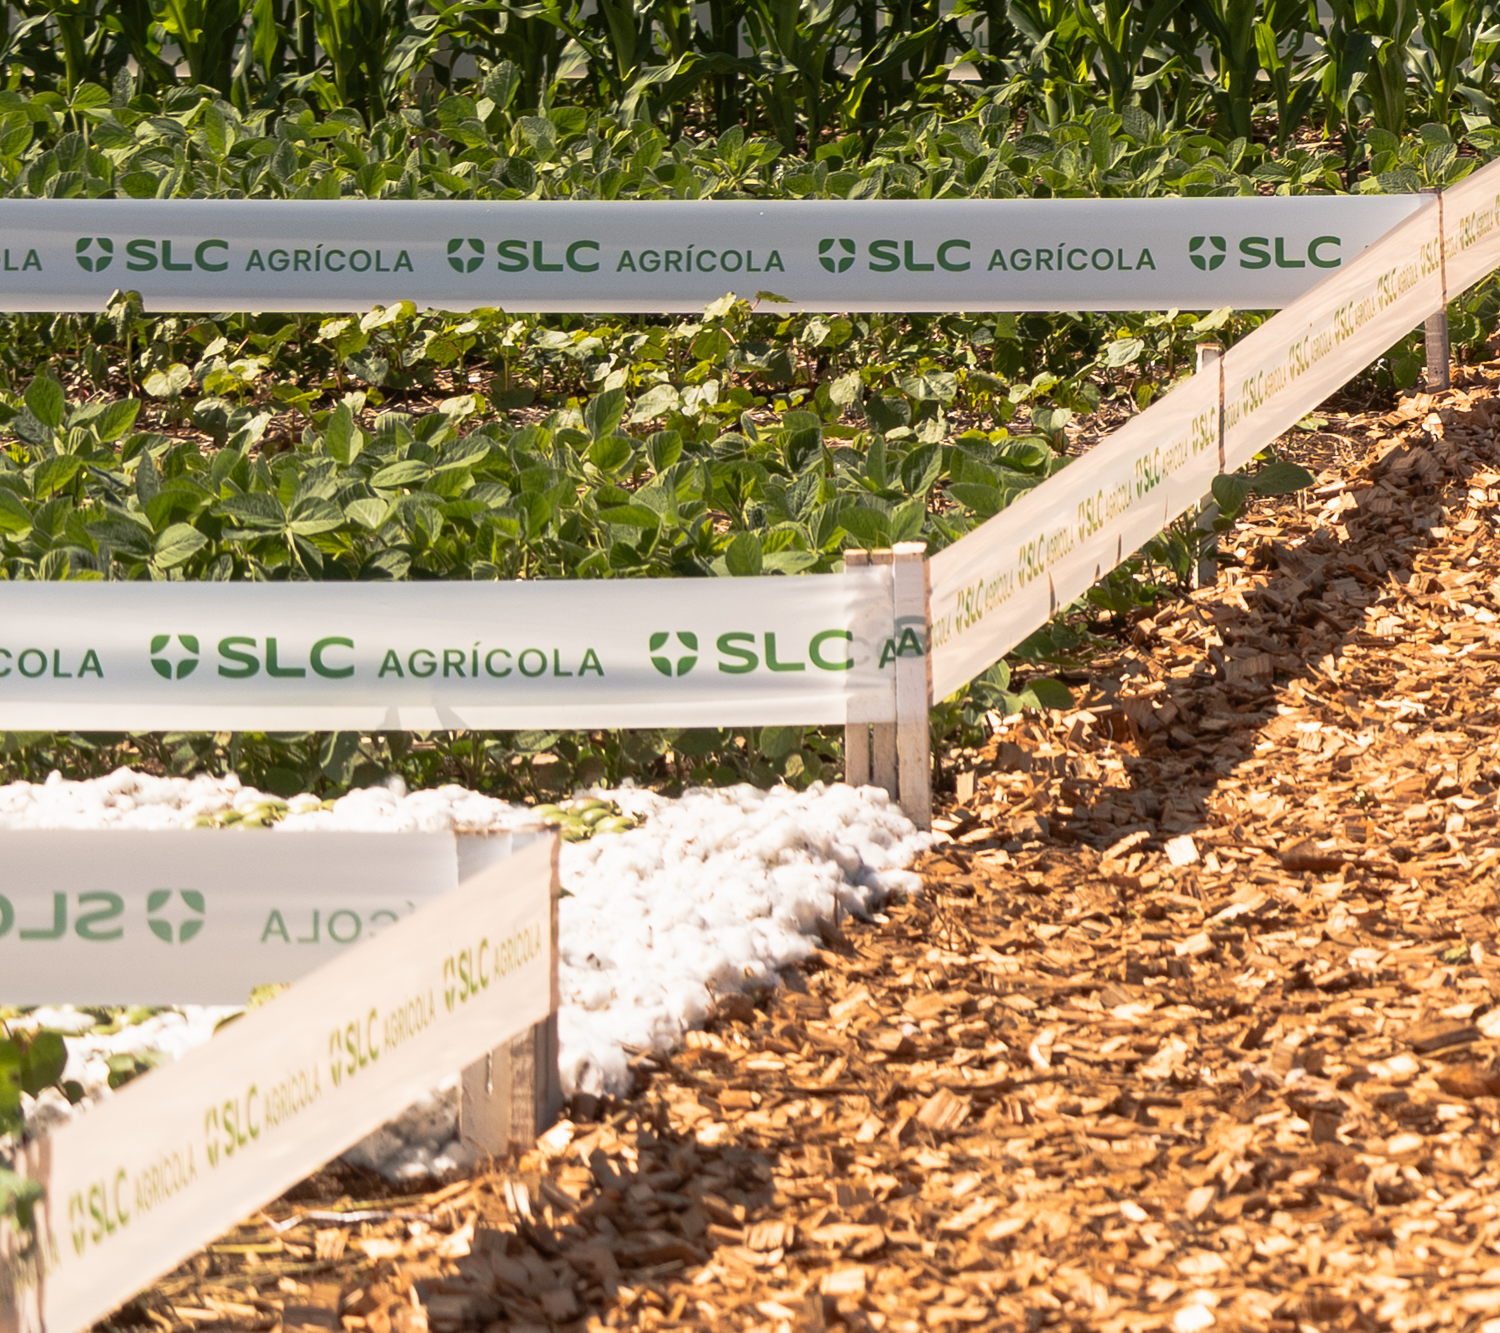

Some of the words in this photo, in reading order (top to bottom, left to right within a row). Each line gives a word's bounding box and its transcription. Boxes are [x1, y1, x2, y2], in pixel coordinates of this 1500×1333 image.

[126, 238, 229, 273] SLC
[245, 241, 414, 273] AGRÍCOLA
[497, 238, 600, 273] SLC
[616, 241, 785, 273] AGRÍCOLA
[869, 239, 971, 273] SLC
[988, 242, 1156, 272] AGRÍCOLA
[1239, 235, 1342, 270] SLC
[1384, 267, 1397, 305] SLC
[1340, 301, 1354, 341] SLC
[1296, 335, 1310, 376] SLC
[1250, 370, 1263, 413] SLC
[1200, 406, 1216, 451] SLC
[1144, 446, 1160, 493] SLC
[1087, 489, 1103, 537] SLC
[1026, 534, 1045, 578] SLC
[965, 578, 984, 629] SLC
[217, 636, 355, 680] SLC
[377, 642, 605, 679] AGRÍCOLA
[717, 629, 855, 675] SLC
[458, 937, 490, 1002] SLC
[493, 923, 543, 979] AGRÍCOLA
[345, 1007, 379, 1076] SLC
[384, 991, 436, 1050] AGRÍCOLA
[223, 1083, 260, 1157] SLC
[87, 1166, 130, 1245] SLC
